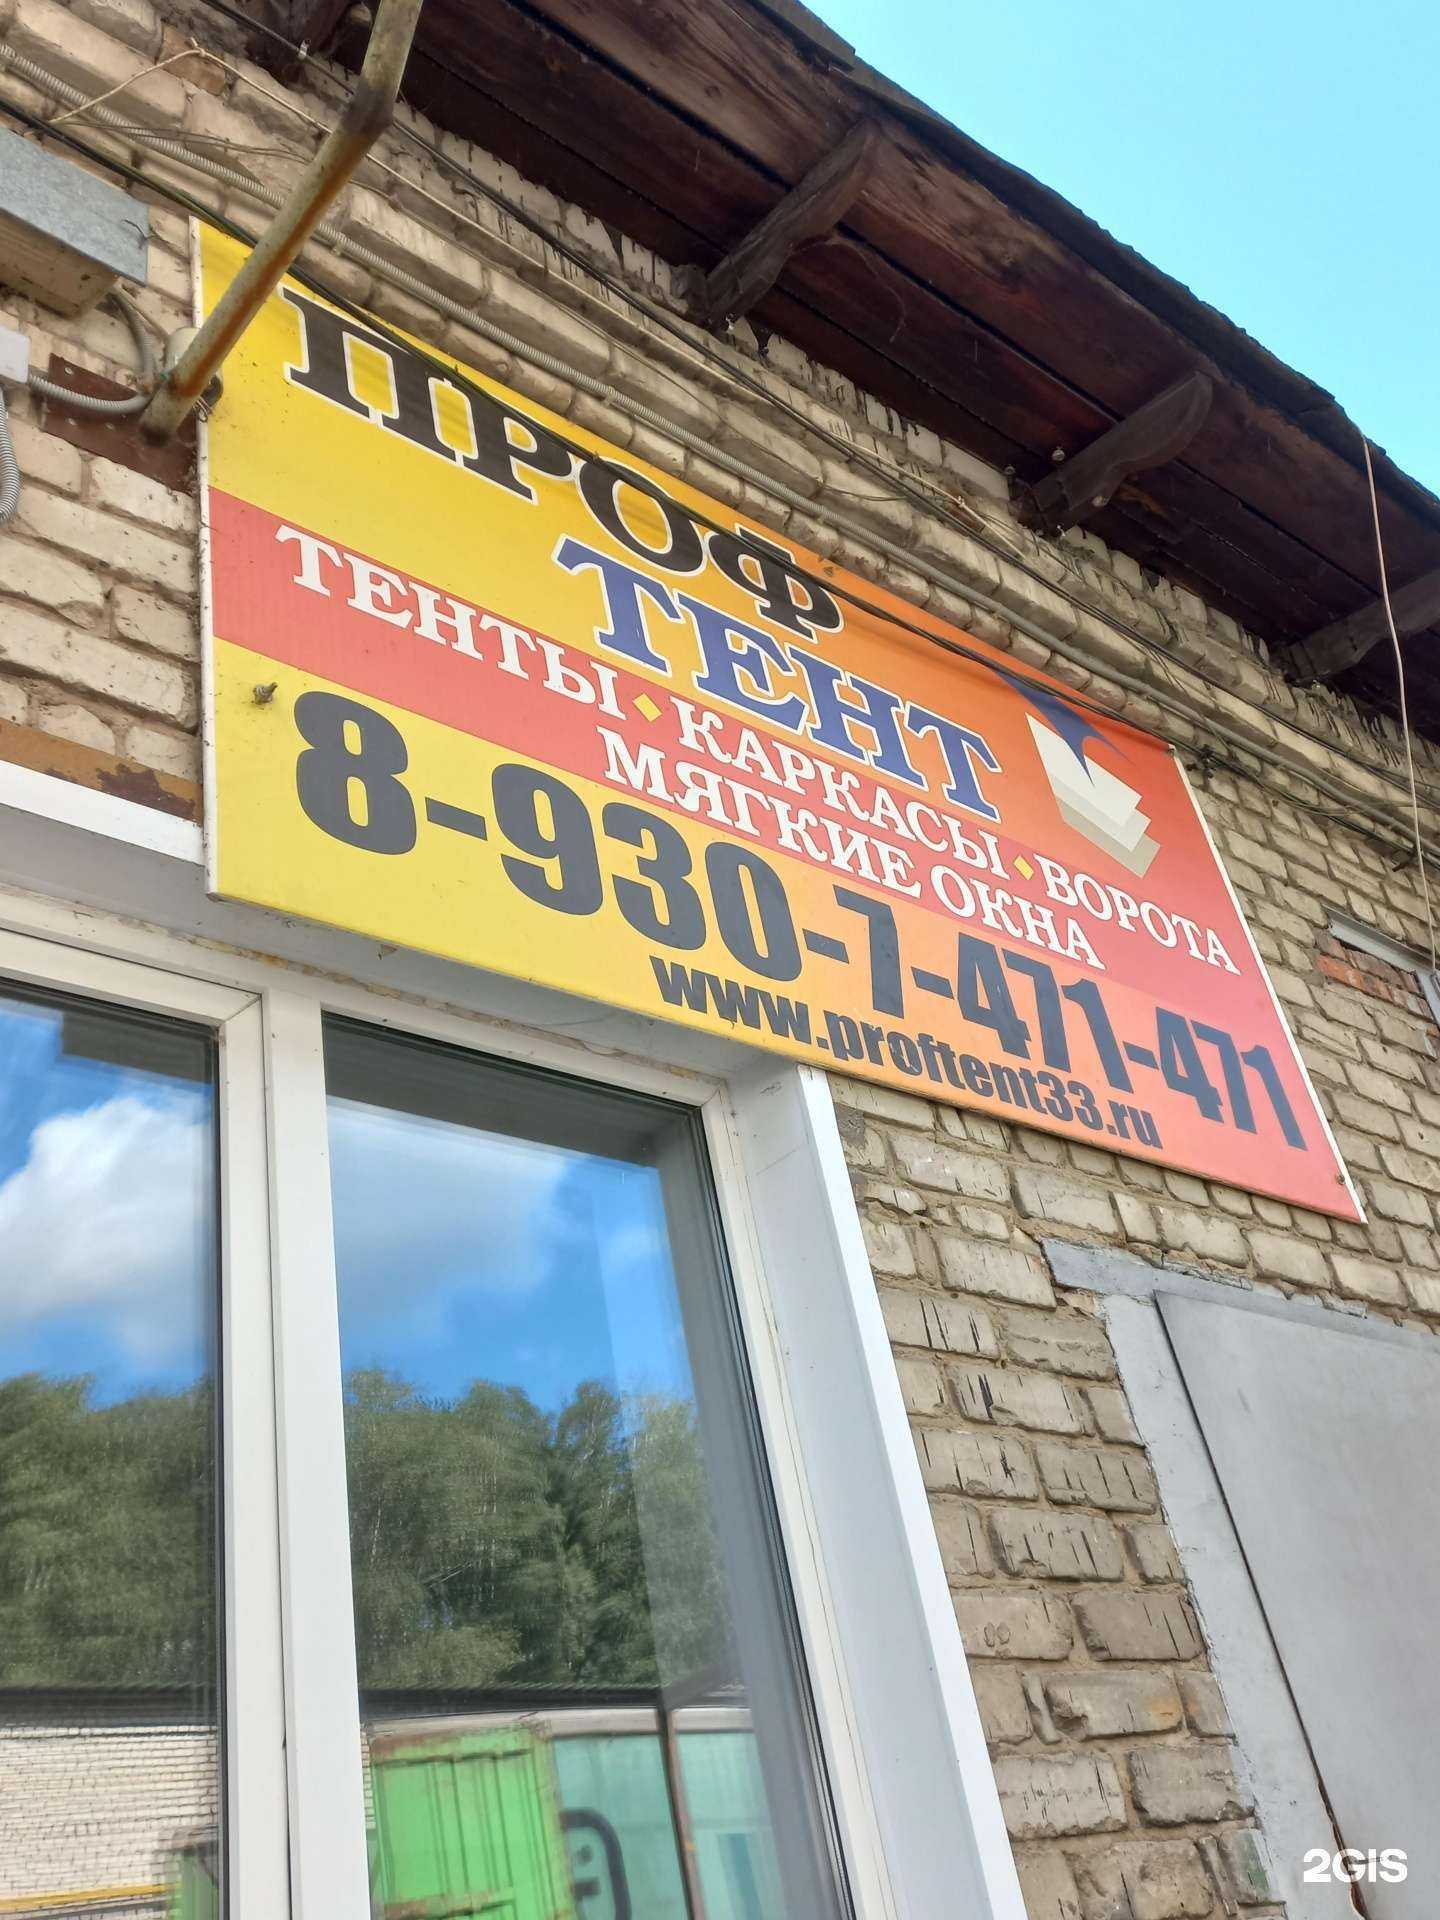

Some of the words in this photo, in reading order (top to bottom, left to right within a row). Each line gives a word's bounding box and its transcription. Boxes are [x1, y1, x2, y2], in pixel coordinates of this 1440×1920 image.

[278, 285, 844, 642] ПРОФ
[275, 525, 628, 720] ТЕНТЫ
[668, 695, 1010, 880] КАРКАСЫ
[1034, 854, 1241, 976] ВОРОТА
[552, 533, 1002, 822] ТЕНТ
[293, 690, 1308, 1151] 8-930-7-471-471
[597, 725, 922, 898] МЯГКИЕ
[932, 865, 1105, 970] ОКНА
[648, 955, 1164, 1151] www.proftent33.ru
